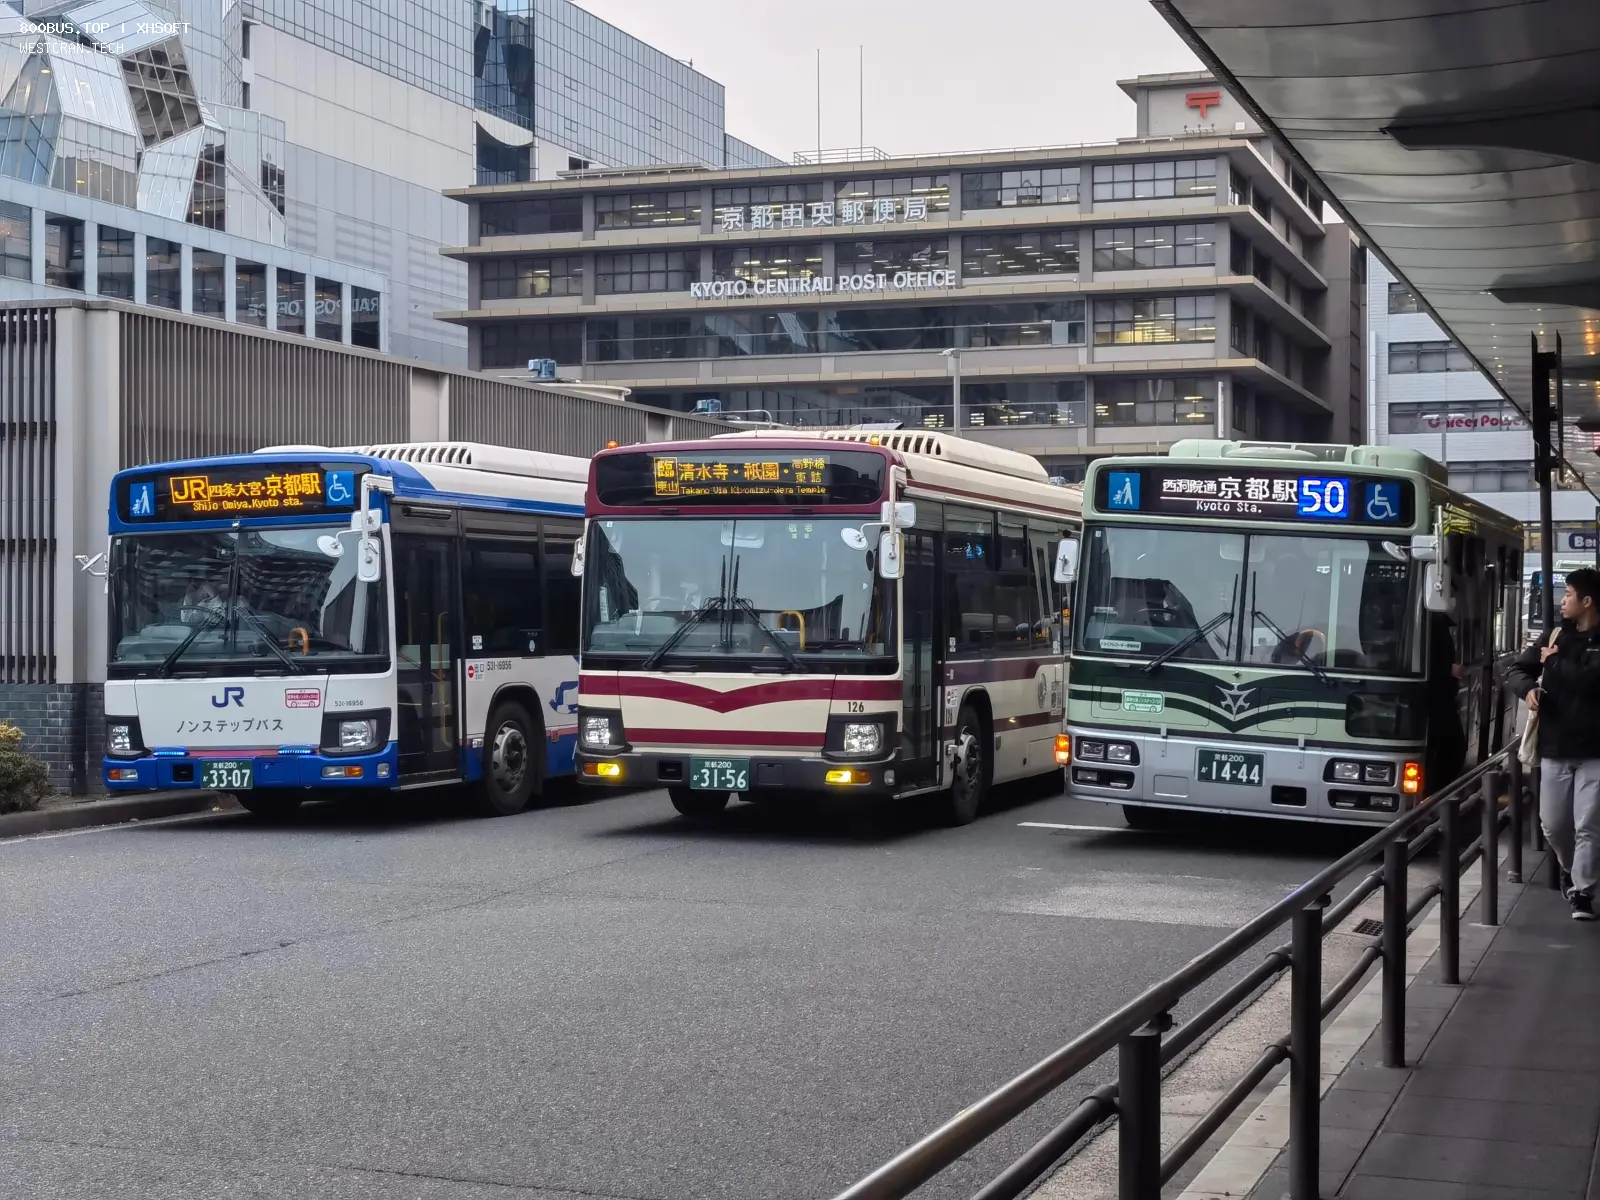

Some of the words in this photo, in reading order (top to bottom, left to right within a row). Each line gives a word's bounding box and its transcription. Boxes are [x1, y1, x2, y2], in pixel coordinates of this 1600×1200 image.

[721, 197, 928, 232] 京都中央郵便局
[690, 280, 748, 298] KYOTO
[753, 277, 833, 295] CENTRAL
[839, 273, 887, 291] POST
[893, 270, 957, 289] OFFICE
[174, 479, 208, 500] JR
[656, 481, 678, 492] 東山
[681, 486, 710, 495] Takano
[730, 486, 794, 495] Kiyomizu-dera
[796, 486, 826, 495] Temple
[1302, 480, 1345, 513] 50
[193, 501, 219, 511] Shijo
[283, 497, 304, 507] sta.
[1196, 500, 1231, 512] Kyoto
[1237, 501, 1263, 513] Sta.
[211, 686, 245, 708] JR
[847, 701, 865, 713] 126
[176, 717, 284, 734] ノンステップバス
[209, 769, 251, 788] 33-07
[700, 768, 747, 789] 31-56
[1211, 761, 1260, 784] 14-44
